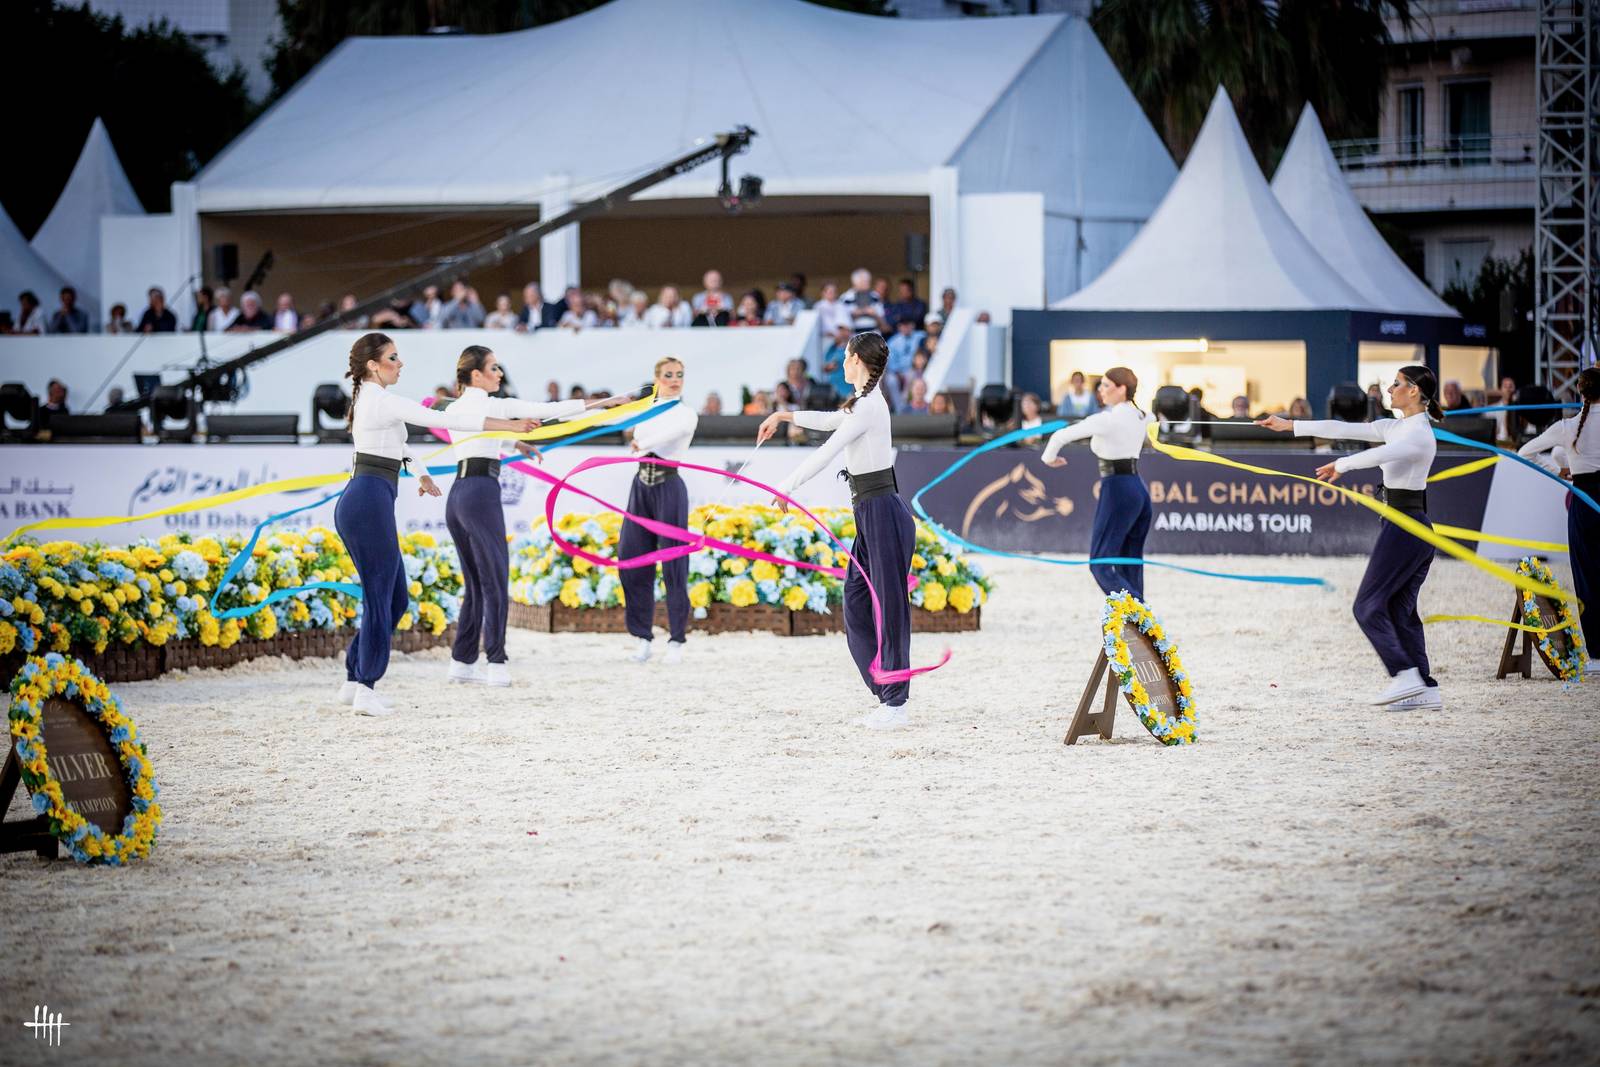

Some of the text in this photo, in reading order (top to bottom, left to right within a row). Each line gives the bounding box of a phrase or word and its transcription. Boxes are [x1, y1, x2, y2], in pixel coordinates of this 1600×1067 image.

[15, 501, 71, 519] BANK
[165, 512, 200, 529] Old
[1154, 511, 1312, 533] ARABIANS TOUR
[51, 752, 113, 782] ILVER
[72, 796, 118, 815] HAMPION
